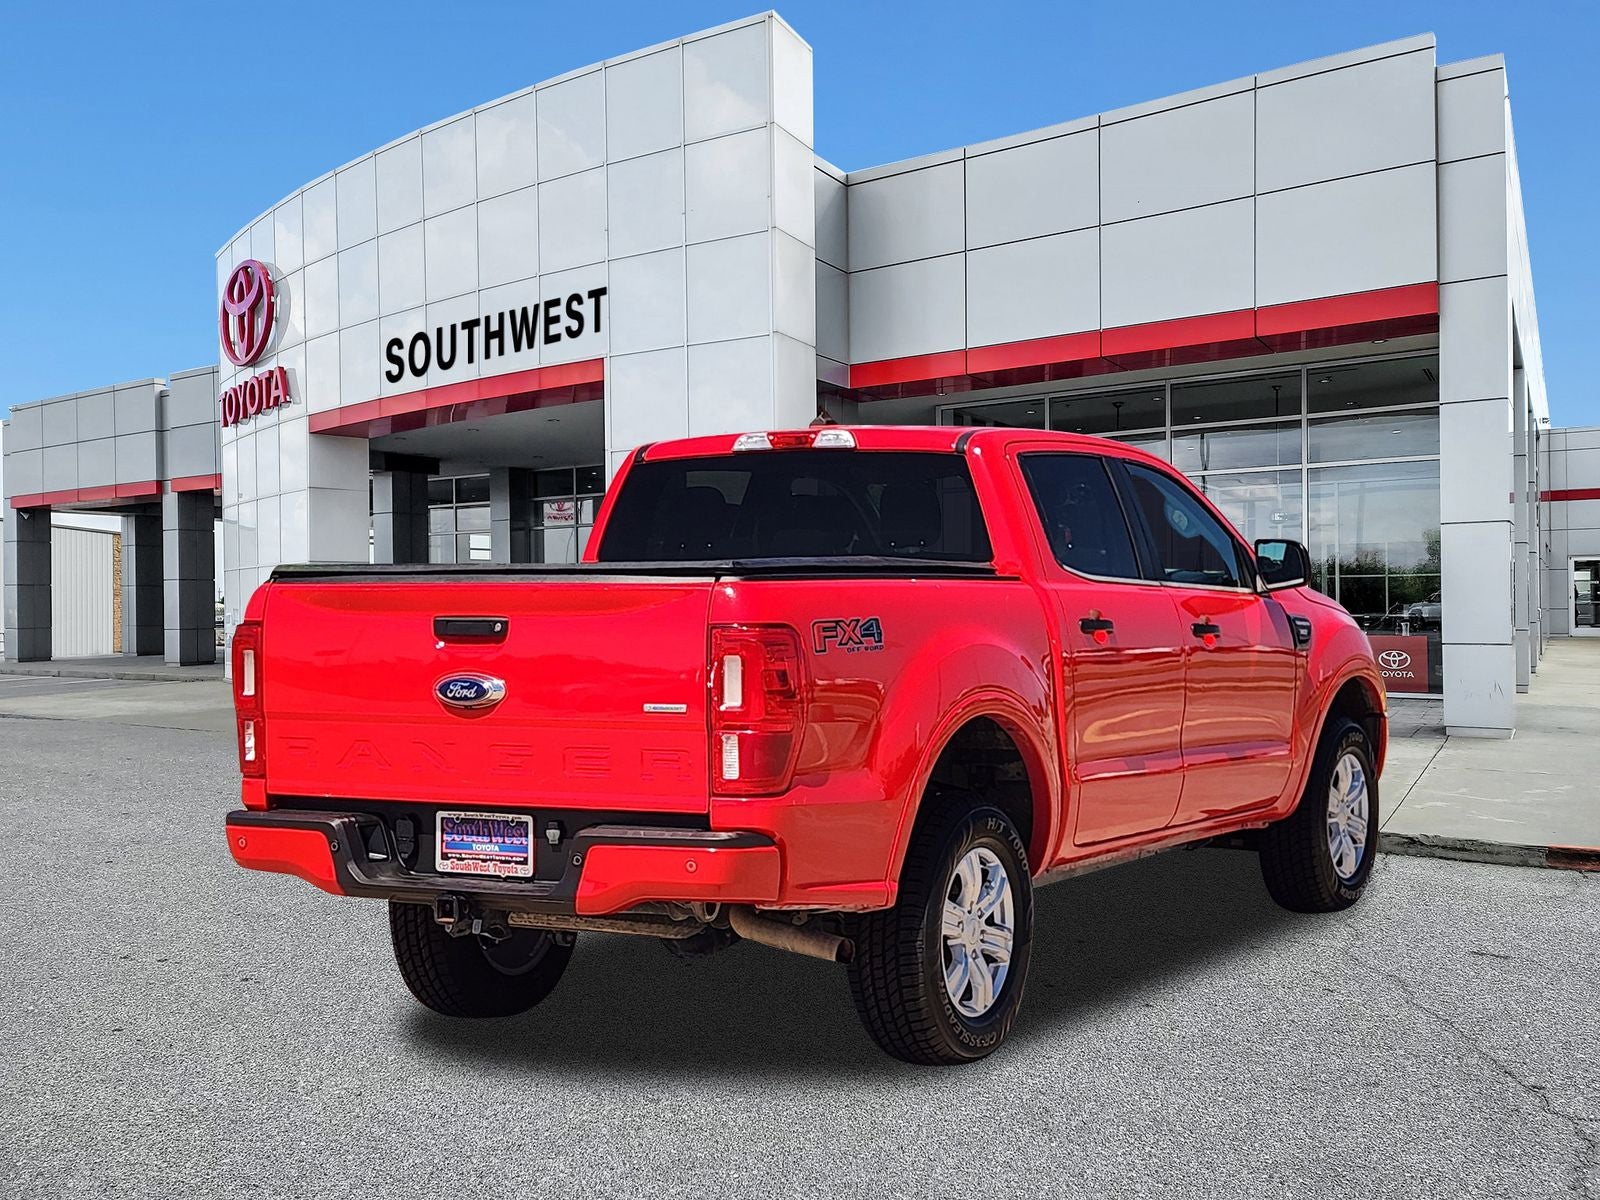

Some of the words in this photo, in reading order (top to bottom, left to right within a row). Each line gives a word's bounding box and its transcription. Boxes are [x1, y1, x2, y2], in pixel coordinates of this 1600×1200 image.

[385, 286, 608, 384] SOUTHWEST
[218, 366, 291, 427] TOYOTA
[811, 617, 883, 654] FX4
[446, 681, 478, 698] Ford
[279, 736, 692, 782] RANGER
[472, 844, 499, 852] TOYOTA
[1008, 830, 1029, 871] 7000
[492, 863, 519, 876] Toyota
